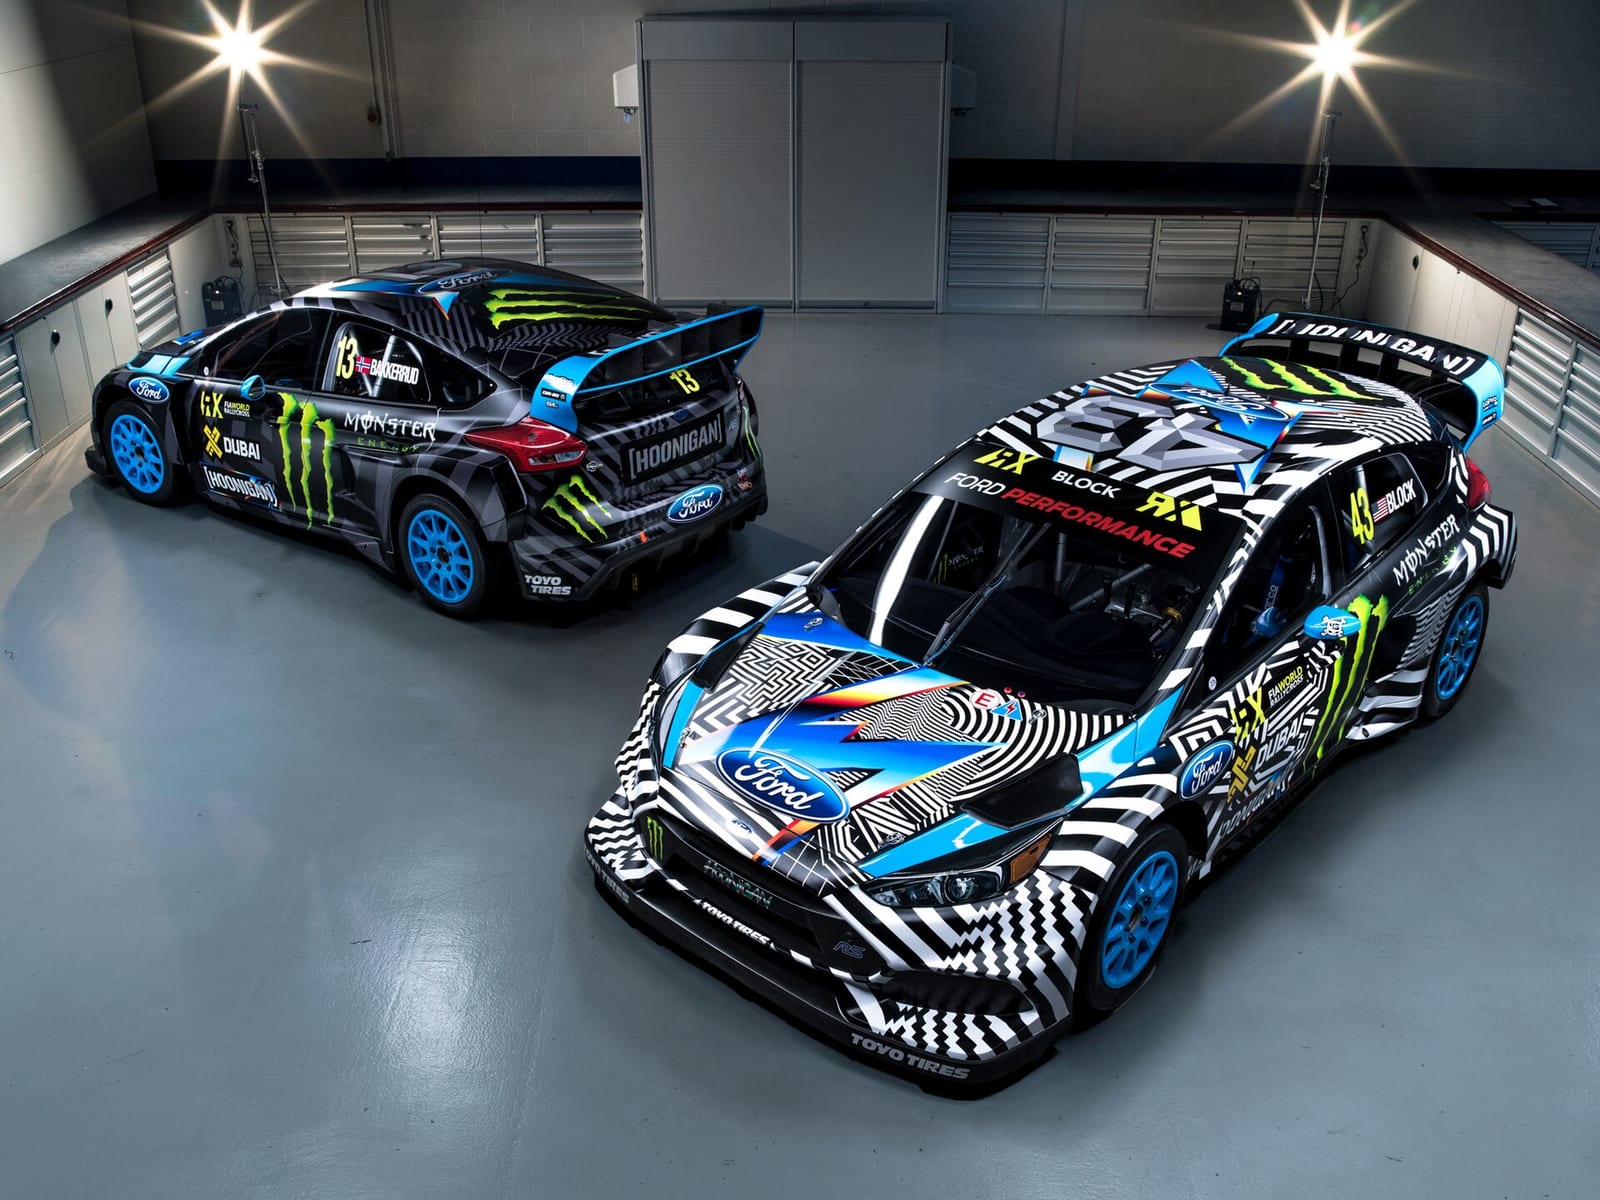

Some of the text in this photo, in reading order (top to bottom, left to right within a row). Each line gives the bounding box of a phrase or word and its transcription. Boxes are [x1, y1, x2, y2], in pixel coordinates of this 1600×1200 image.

[335, 335, 419, 385] 13 BAKKERRUD
[136, 380, 162, 400] Ford
[669, 367, 701, 395] 13
[344, 410, 437, 441] MONSTER
[223, 436, 261, 461] DUBAI
[1051, 470, 1122, 499] BLOCK
[678, 491, 714, 518] Ford
[944, 472, 1196, 559] FORD PERFORMANCE
[1350, 478, 1417, 545] 43 BLOCK
[1392, 513, 1460, 587] MONSTER
[524, 574, 562, 585] TOYO
[530, 585, 572, 596] TIRES
[975, 692, 995, 707] E
[734, 756, 825, 810] Ford
[1191, 751, 1224, 794] Ford
[701, 901, 771, 945] TOYO TIRES
[833, 940, 866, 959] RS
[851, 1033, 970, 1079] TOYO TIRES
